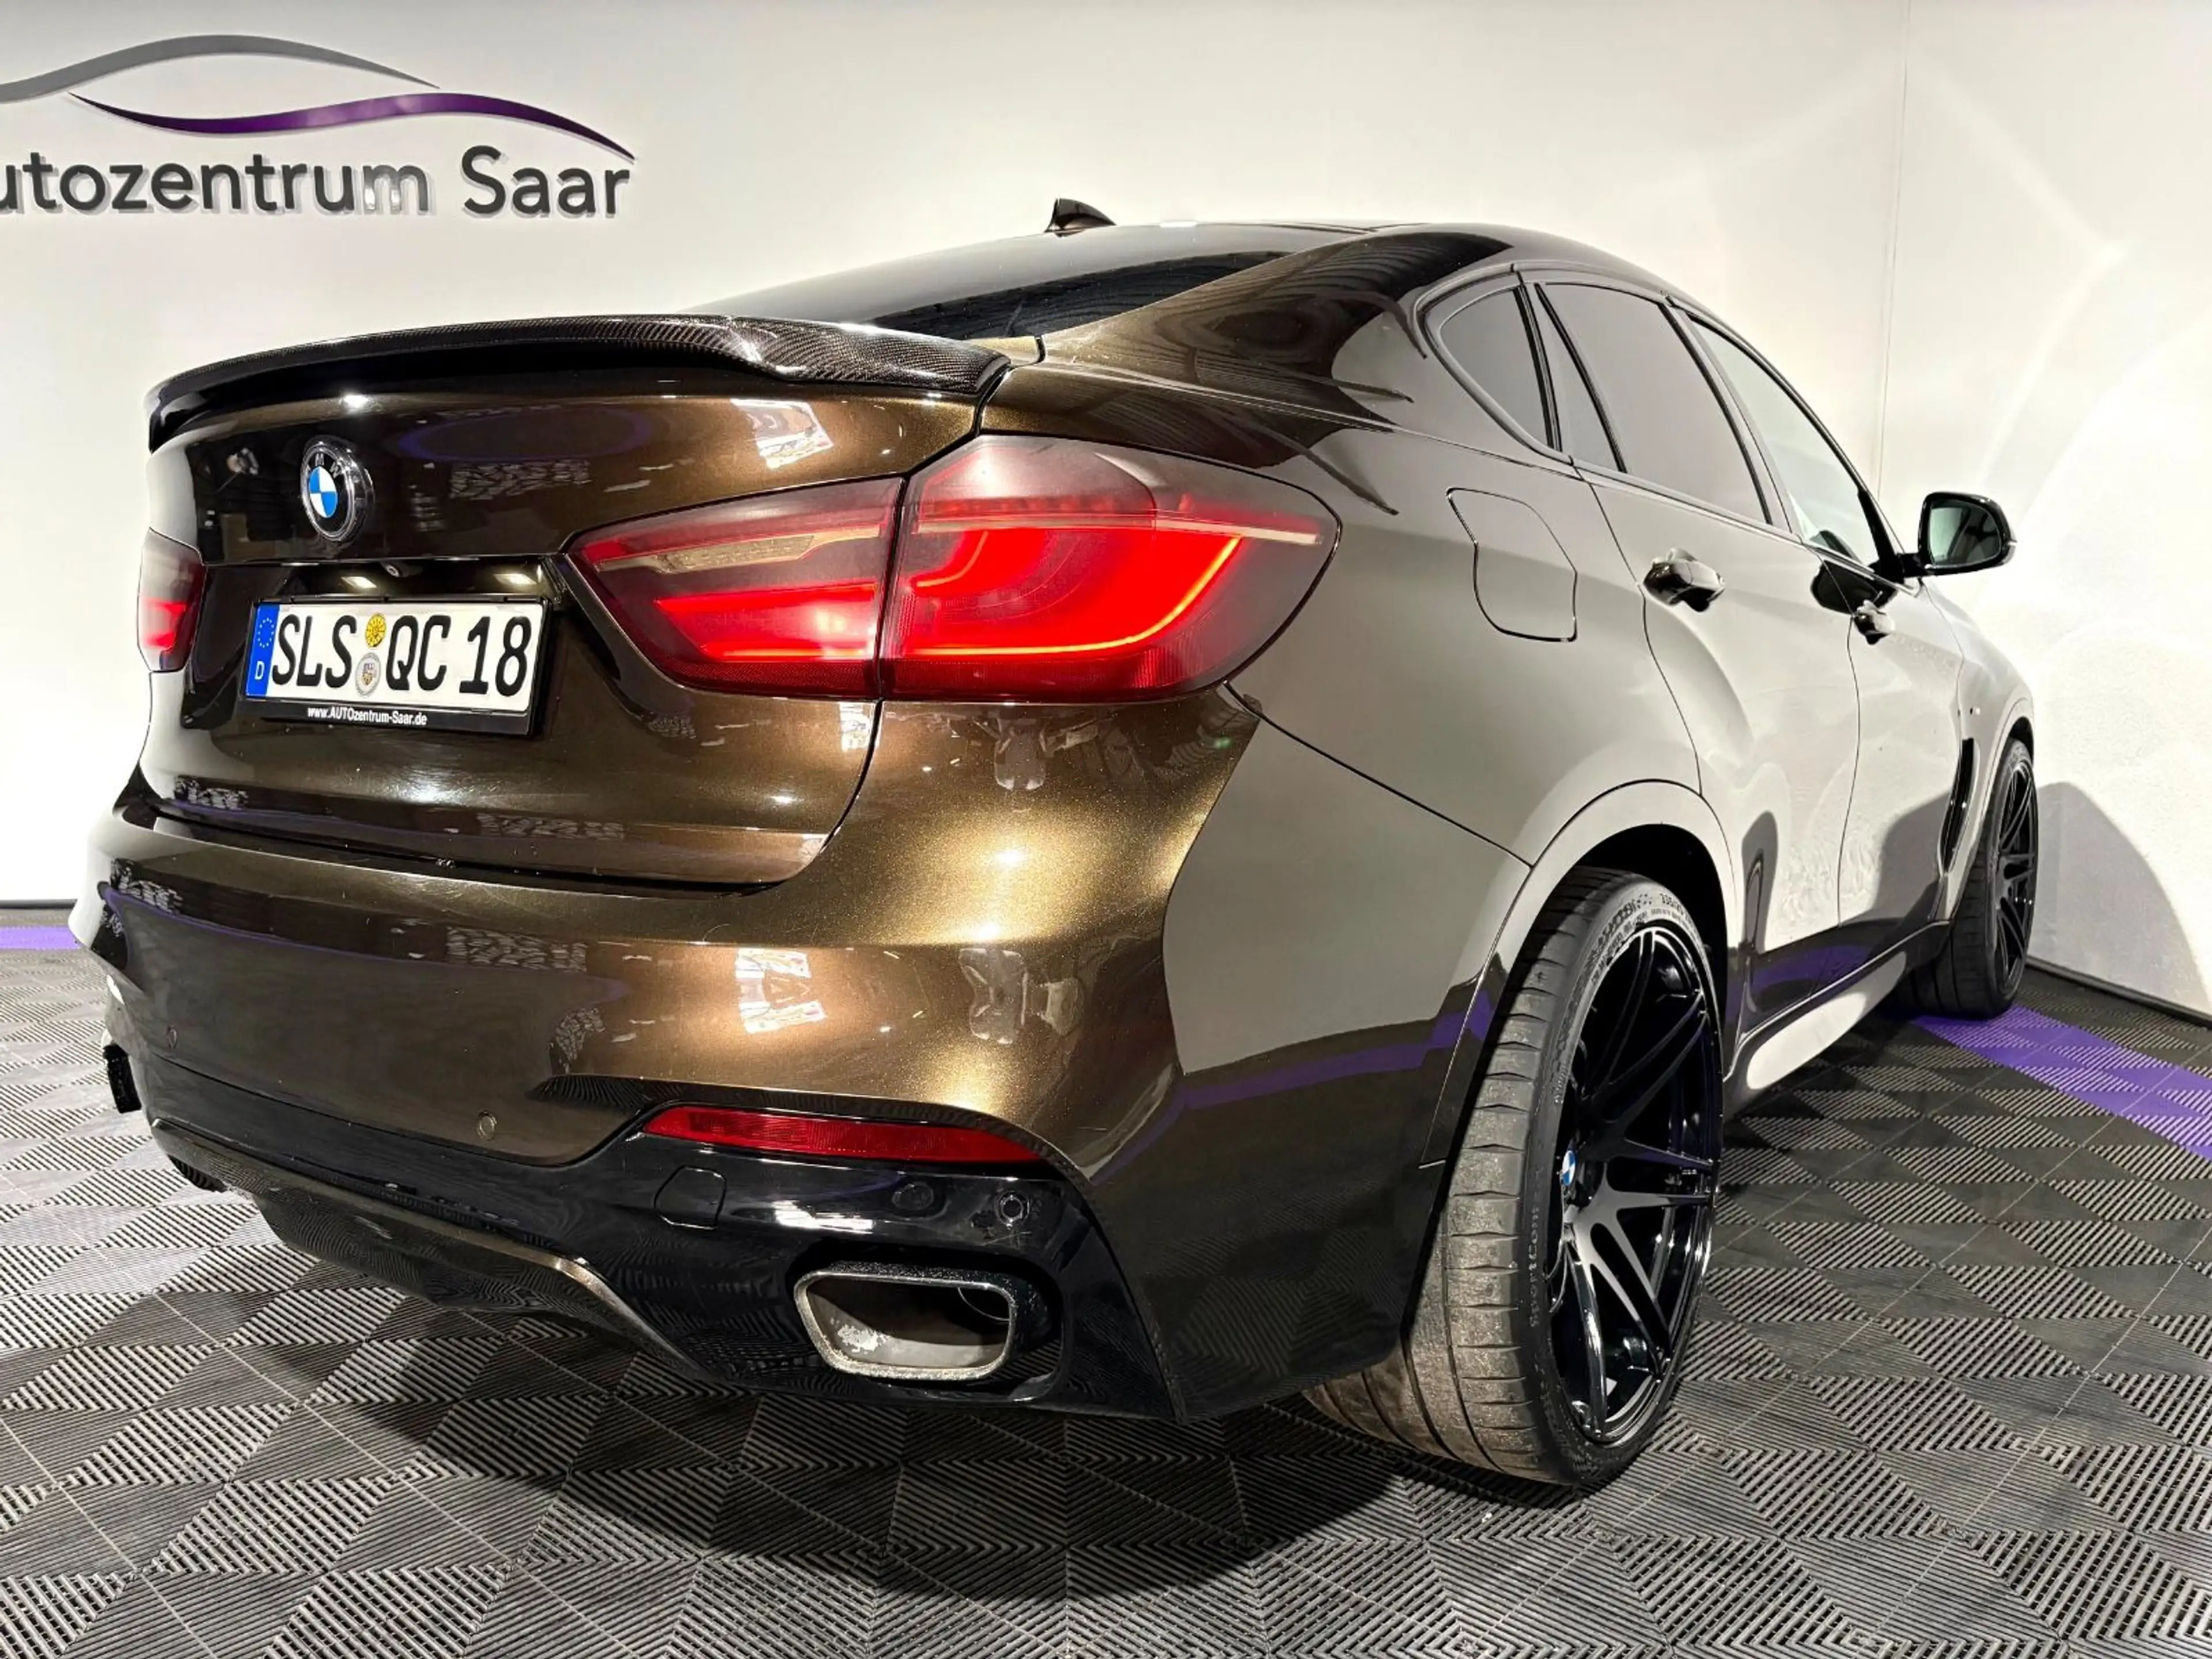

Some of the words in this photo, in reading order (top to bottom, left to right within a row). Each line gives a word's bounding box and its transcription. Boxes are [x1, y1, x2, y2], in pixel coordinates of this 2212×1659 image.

[461, 145, 630, 214] Saar
[255, 661, 266, 680] D
[272, 614, 357, 688] SLS
[386, 615, 452, 691] QC
[459, 616, 532, 697] 18
[307, 706, 428, 725] www.AUTOzentrum-Saar.de
